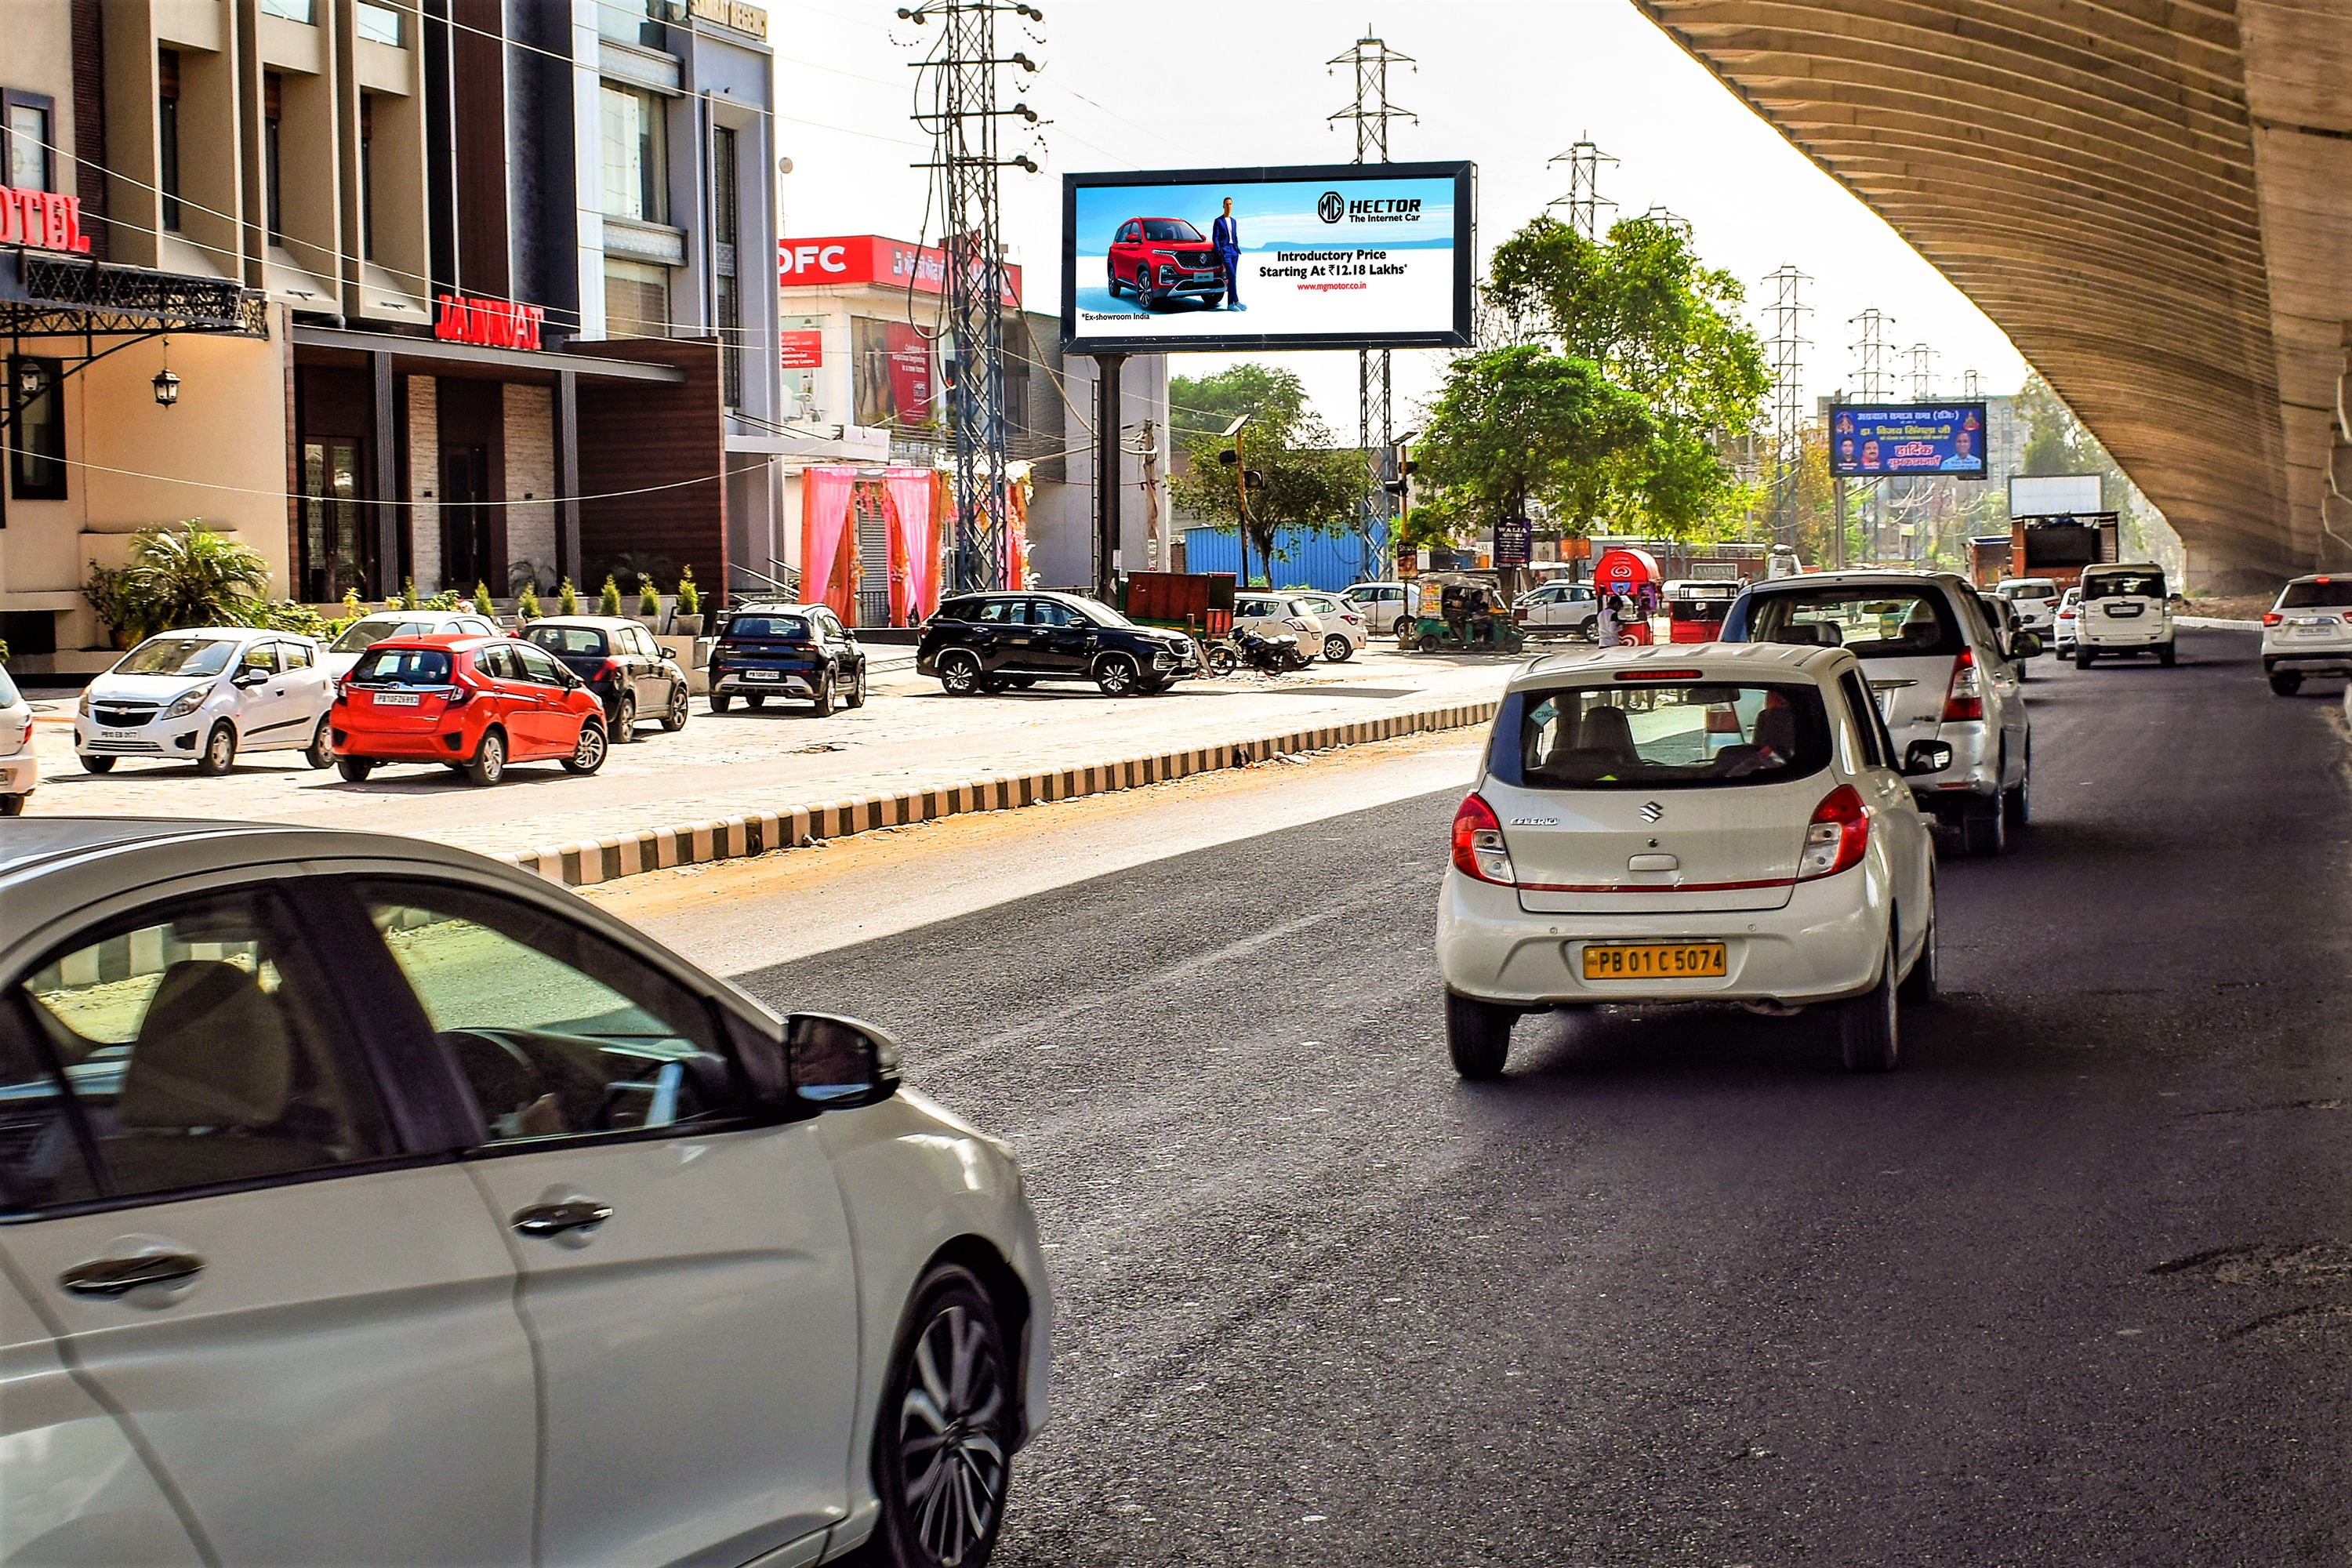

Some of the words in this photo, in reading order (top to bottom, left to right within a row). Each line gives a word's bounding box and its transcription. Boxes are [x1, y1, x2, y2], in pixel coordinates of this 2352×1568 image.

[1319, 192, 1343, 223] MG
[1349, 199, 1421, 213] HECTOR
[1277, 251, 1353, 263] Introductory
[1357, 249, 1386, 260] Price
[1259, 267, 1308, 279] Starting
[1310, 266, 1326, 276] At
[1329, 264, 1366, 276] ₹12.18
[1298, 281, 1367, 292] www.mgmotor.co.in
[435, 294, 544, 350] JANNAT
[1894, 441, 1934, 456] हार्दिक
[1535, 710, 1553, 718] CNG
[1599, 951, 1622, 973] PB
[1628, 951, 1650, 971] 01
[1658, 951, 1668, 971] C
[1675, 949, 1722, 971] 5074
